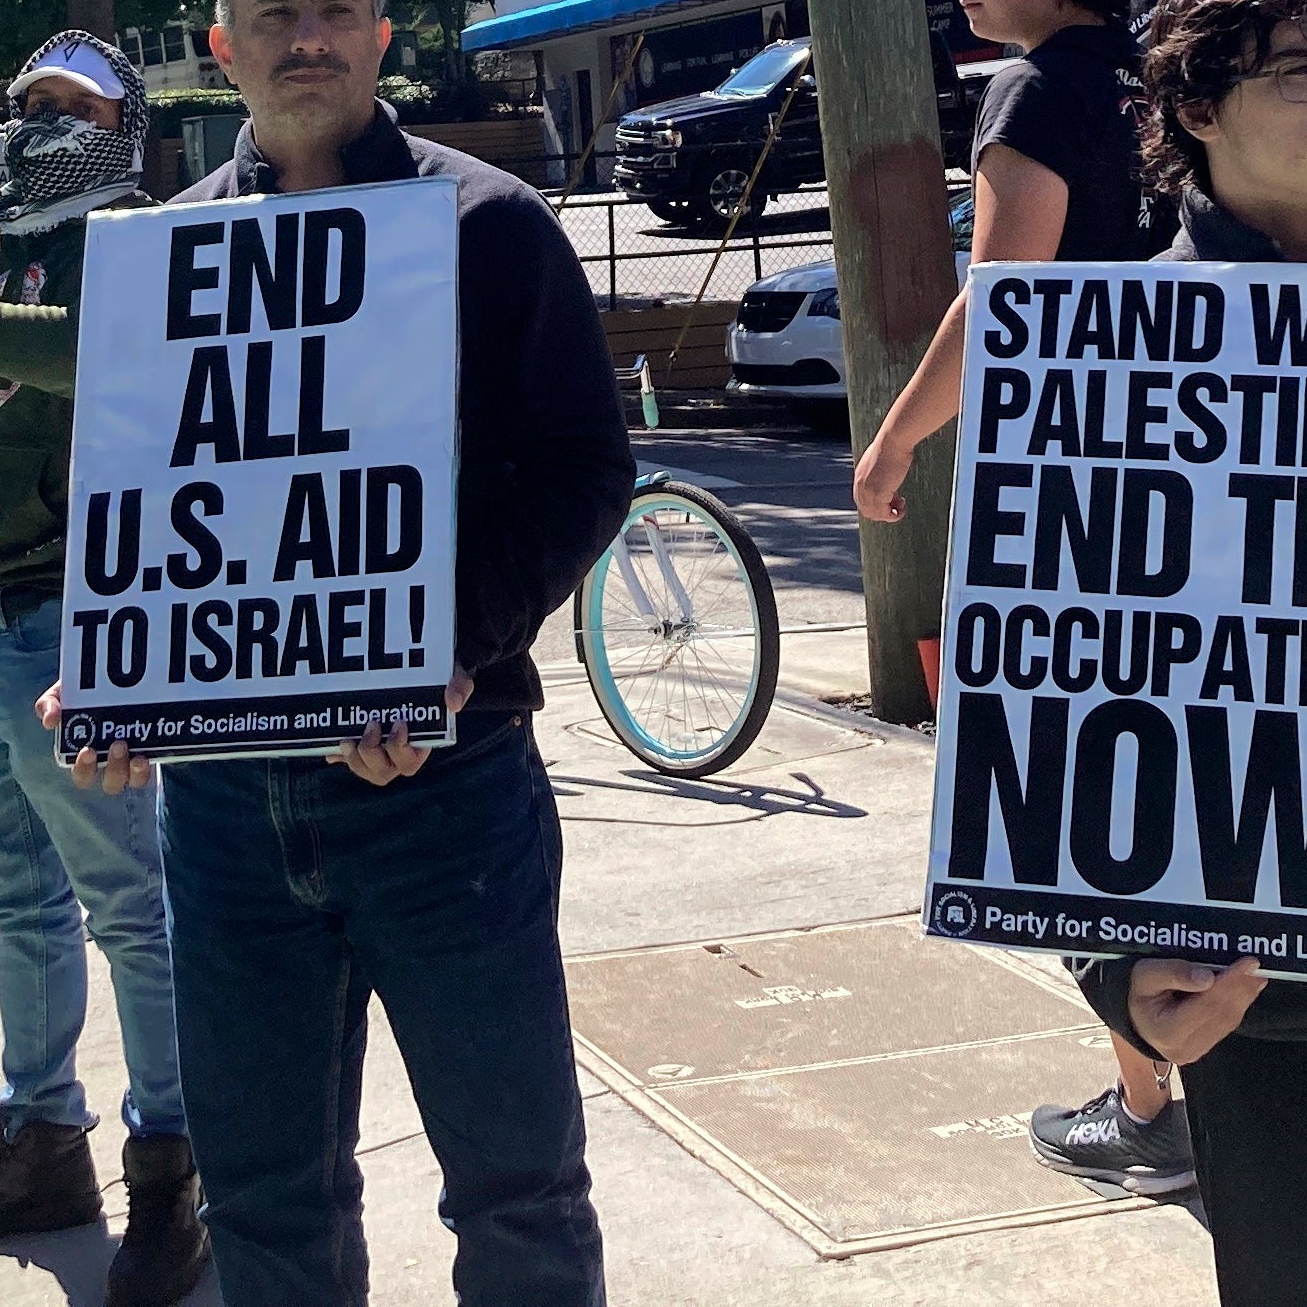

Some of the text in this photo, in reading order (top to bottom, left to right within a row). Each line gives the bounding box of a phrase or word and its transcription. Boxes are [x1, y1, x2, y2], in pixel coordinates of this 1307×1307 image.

[167, 208, 365, 341] END
[985, 278, 1224, 362] STAND
[169, 335, 349, 467] ALL
[85, 465, 422, 596] U.S. AID
[966, 462, 1193, 597] END
[73, 585, 424, 690] TO ISRAEL!
[102, 720, 151, 742] Party
[157, 718, 185, 735] for
[190, 713, 287, 733] Socialism
[294, 708, 330, 729] and
[338, 703, 441, 726] Liberation
[985, 906, 1050, 939] Party
[1056, 912, 1092, 937] for
[1099, 917, 1228, 951] Socialism
[1238, 933, 1286, 957] and
[1066, 1117, 1121, 1145] HOKA
